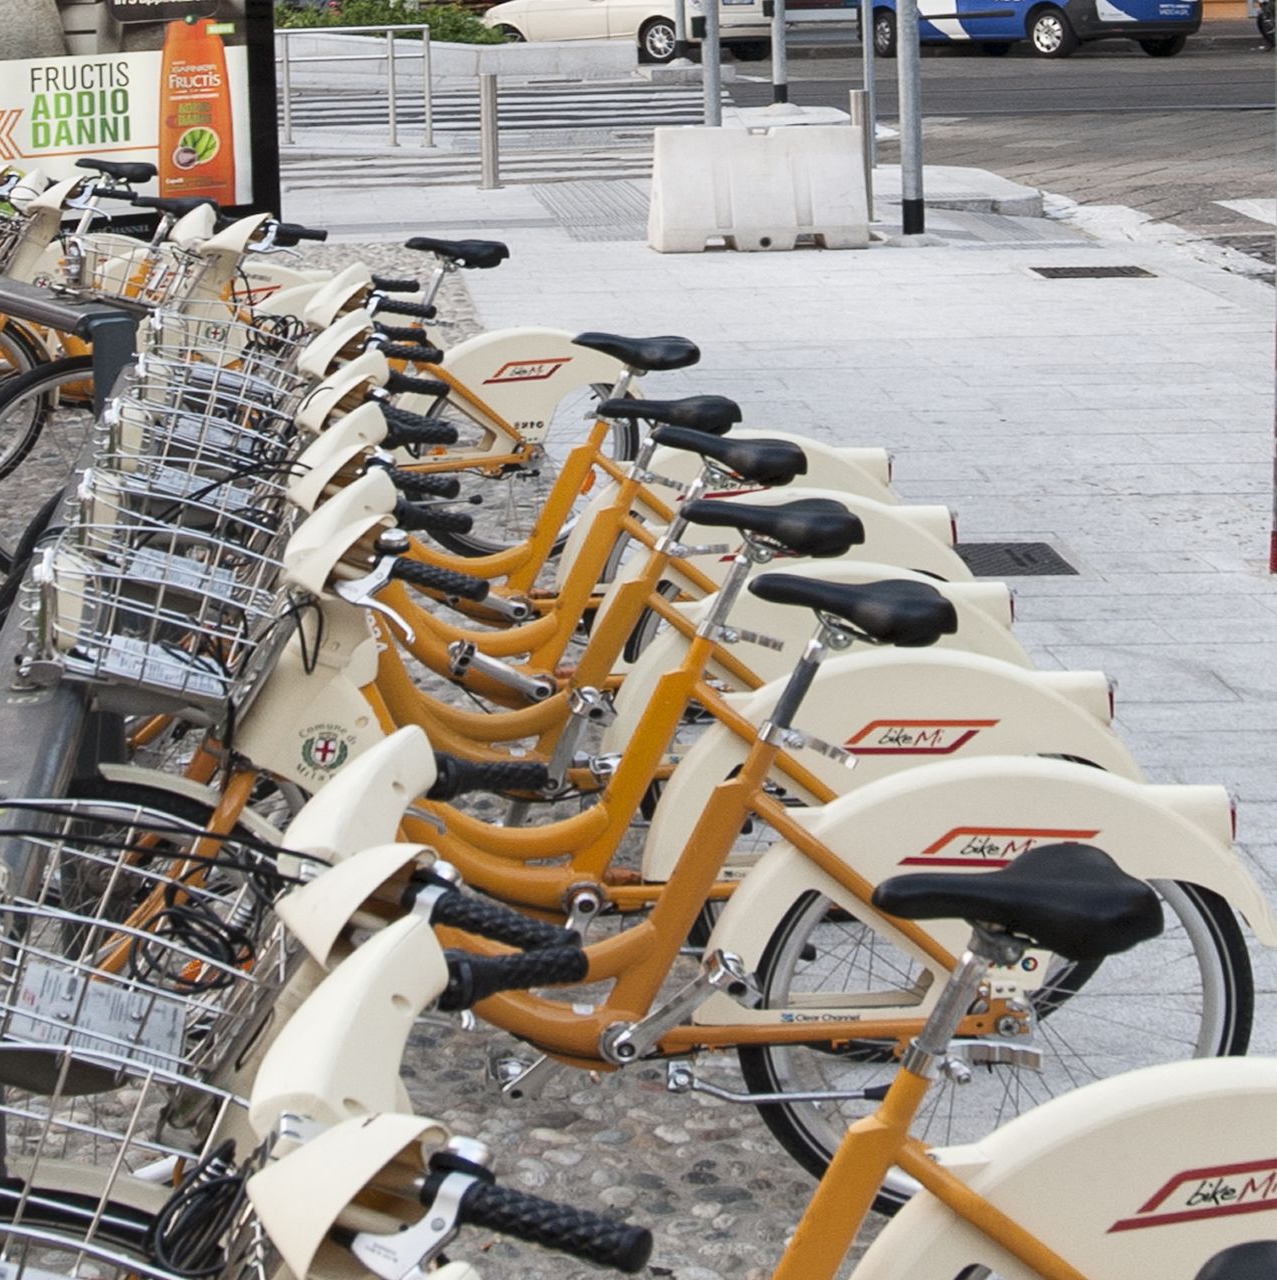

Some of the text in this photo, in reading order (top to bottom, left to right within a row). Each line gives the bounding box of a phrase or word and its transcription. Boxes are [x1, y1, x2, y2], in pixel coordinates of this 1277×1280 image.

[30, 61, 130, 92] FRUCTIS
[31, 88, 129, 121] ADDIO
[31, 115, 131, 149] DANNI
[298, 723, 348, 739] Comune
